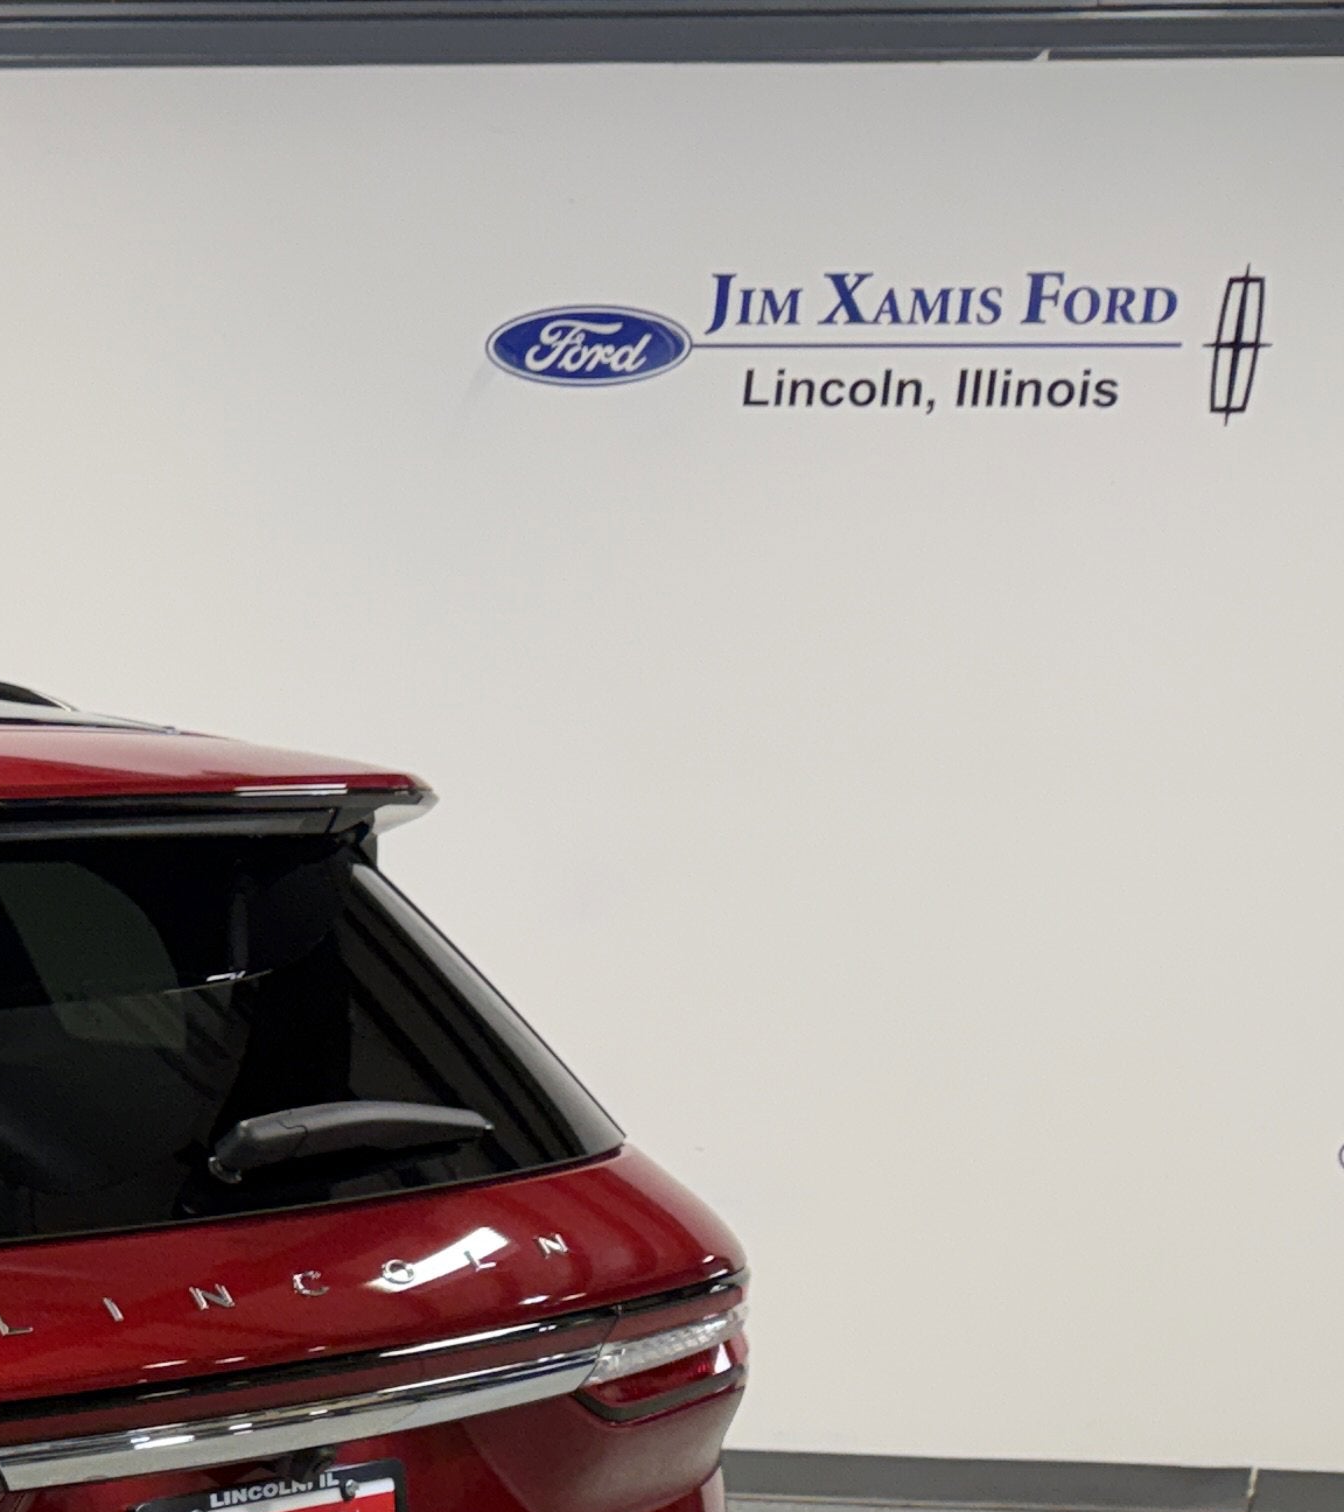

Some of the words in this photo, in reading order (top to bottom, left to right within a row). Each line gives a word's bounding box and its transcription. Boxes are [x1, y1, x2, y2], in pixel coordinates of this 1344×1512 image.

[704, 272, 804, 335] JIM
[816, 272, 1002, 326] XAMIS
[1020, 272, 1179, 326] FORD
[523, 319, 647, 373] Ford
[741, 369, 937, 414] Lincoln,
[954, 368, 1120, 408] Illinois
[319, 1473, 340, 1490] IL
